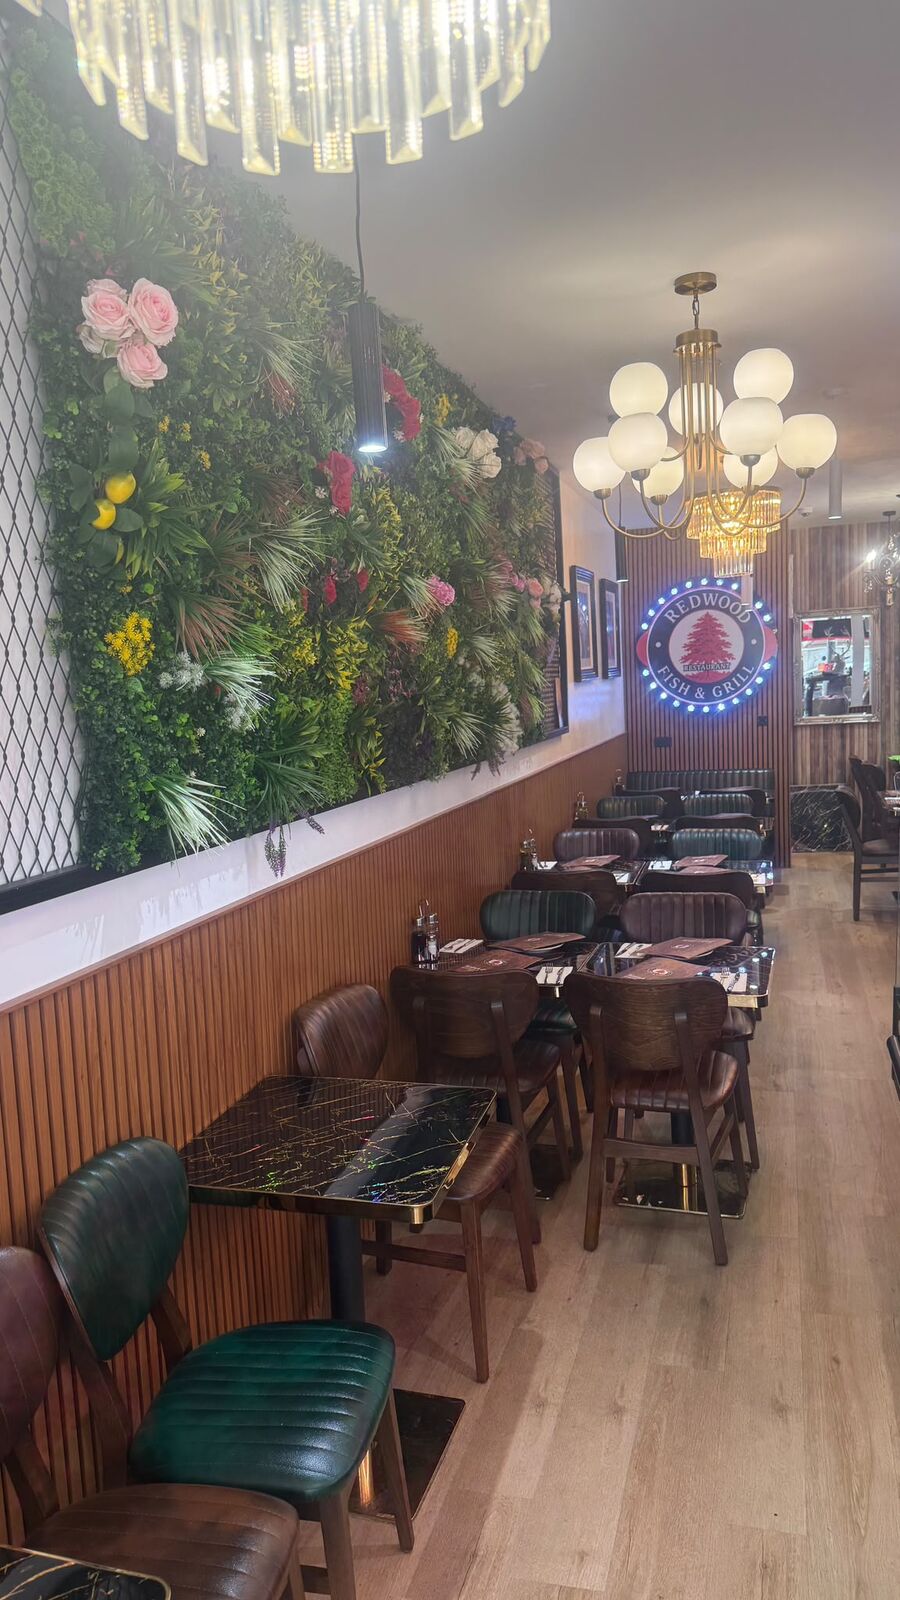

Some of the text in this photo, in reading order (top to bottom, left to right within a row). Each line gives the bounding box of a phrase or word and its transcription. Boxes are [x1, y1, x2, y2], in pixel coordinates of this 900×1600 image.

[664, 592, 751, 623] REDWOOD
[657, 665, 754, 699] FISH & GRILL
[683, 662, 731, 672] RESTAURANT
